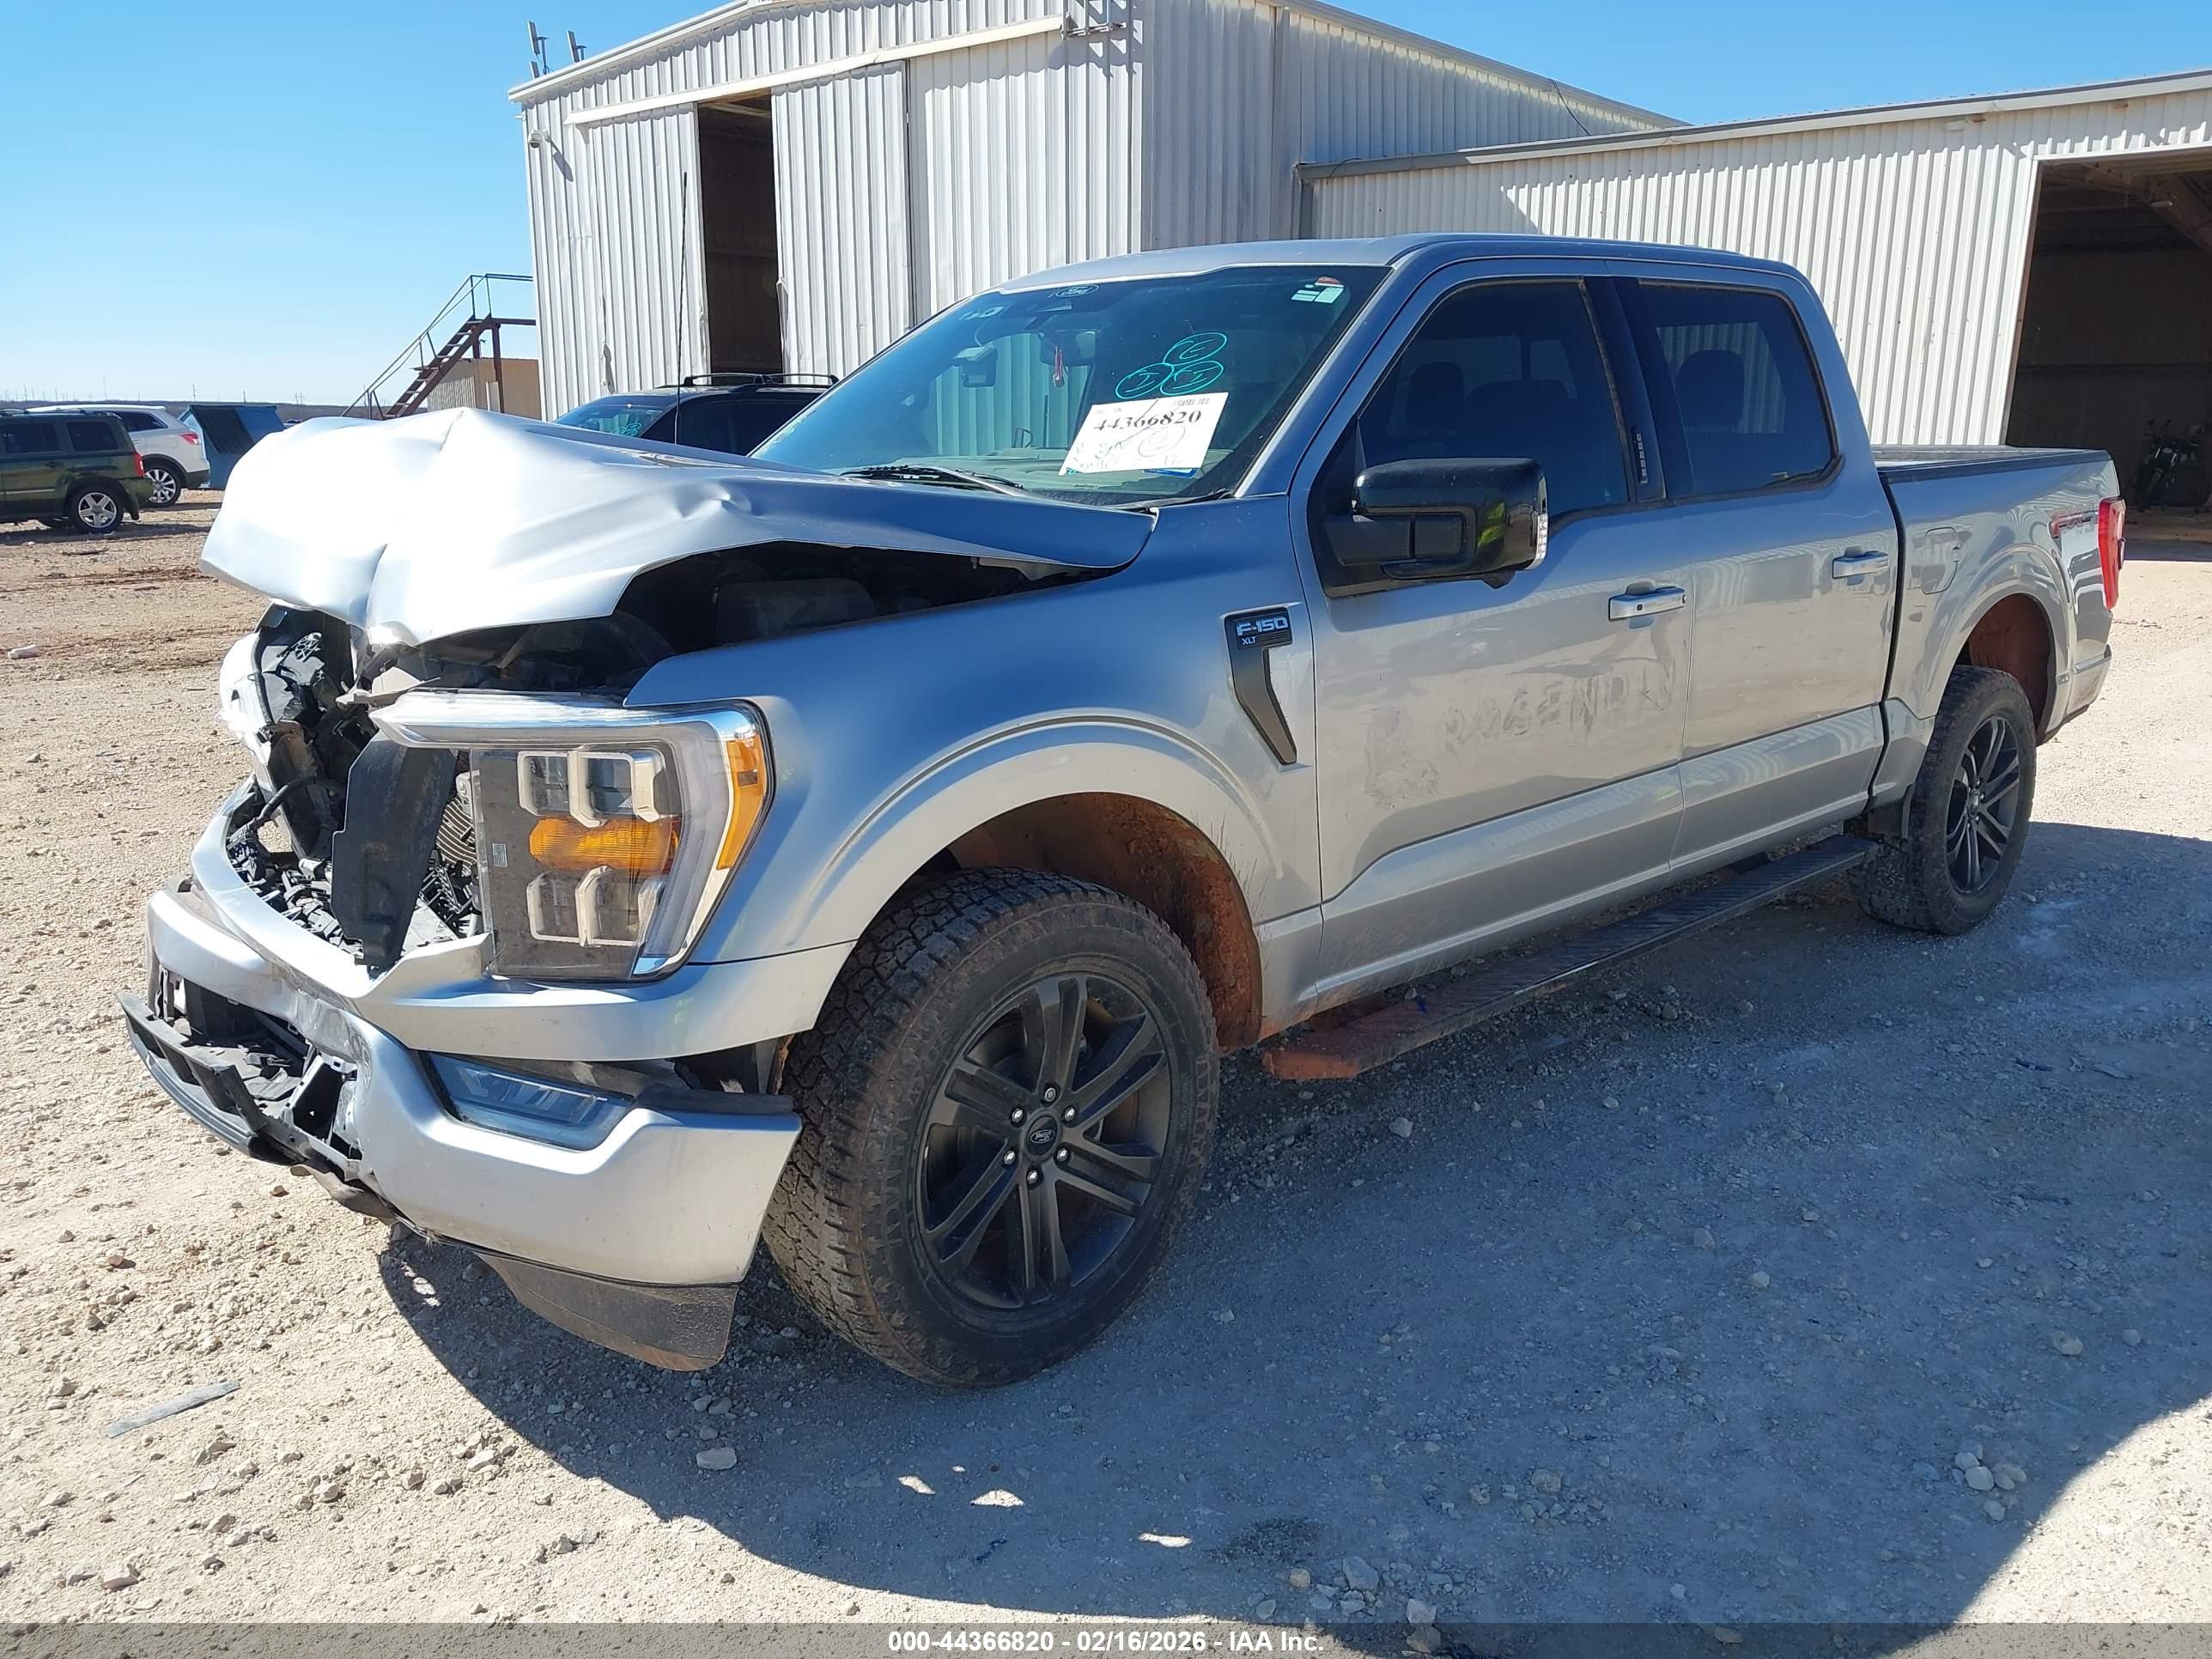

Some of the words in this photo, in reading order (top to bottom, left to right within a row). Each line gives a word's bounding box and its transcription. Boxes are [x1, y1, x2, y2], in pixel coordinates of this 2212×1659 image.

[1093, 409, 1202, 431] 44366820
[1236, 616, 1289, 636] F-150
[1241, 635, 1257, 646] XLT
